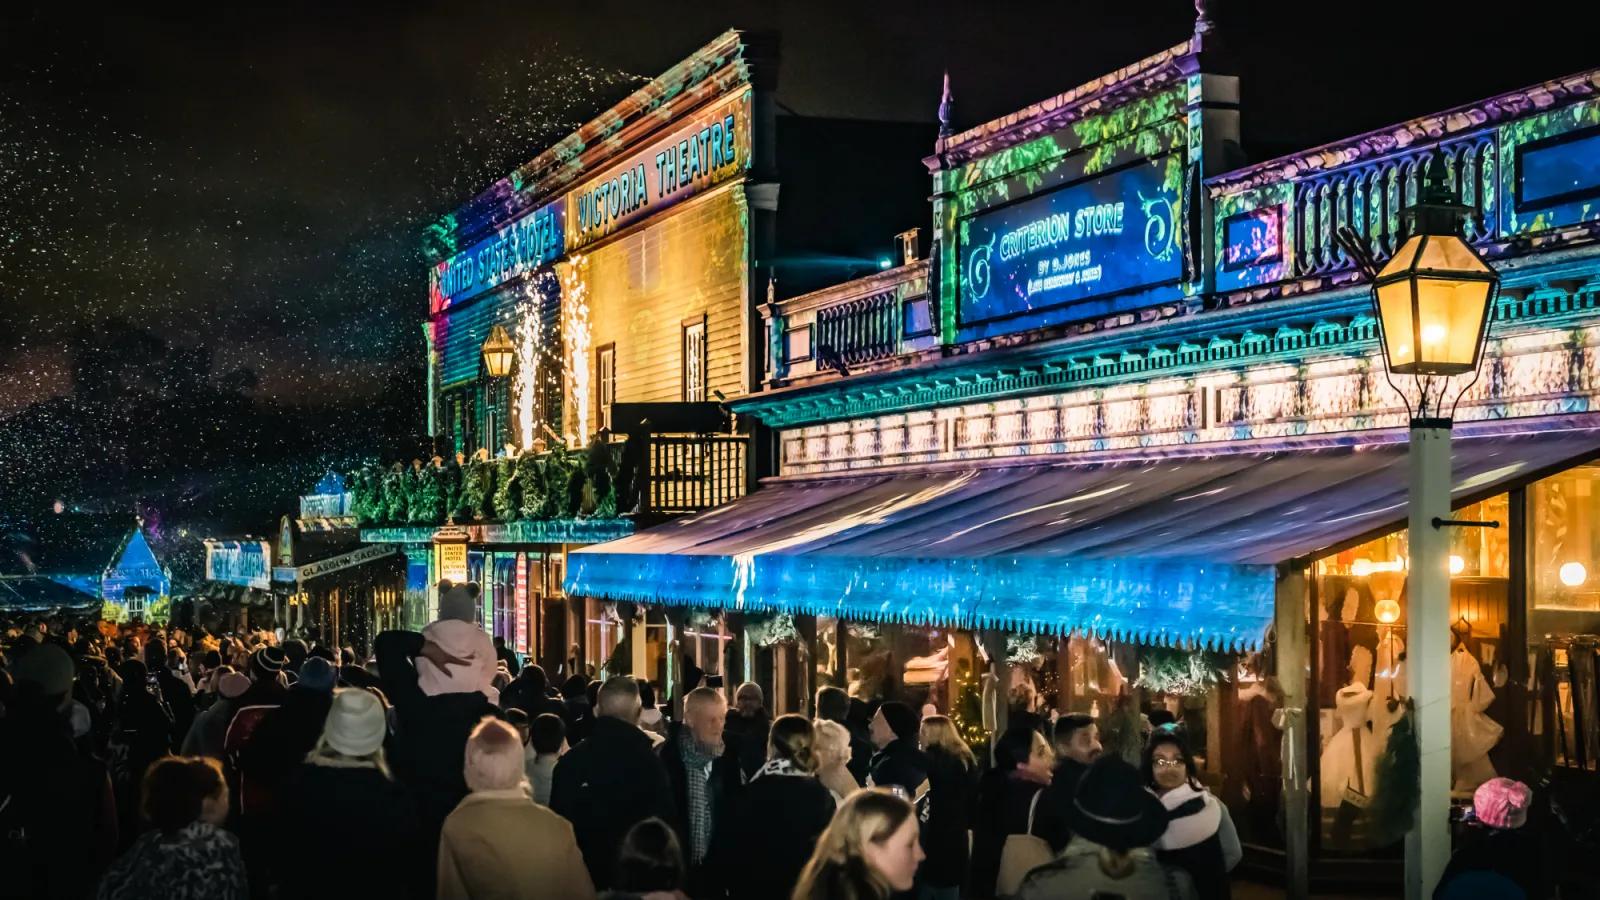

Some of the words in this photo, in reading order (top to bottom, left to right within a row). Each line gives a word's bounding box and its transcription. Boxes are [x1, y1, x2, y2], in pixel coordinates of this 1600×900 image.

[579, 163, 648, 231] VICTORIA
[655, 114, 735, 198] THEATRE
[440, 256, 474, 297] UNITED
[478, 234, 519, 285] STATES
[520, 214, 557, 264] HOTEL
[1000, 212, 1069, 261] CRITERION
[1074, 202, 1124, 238] STORE
[1038, 260, 1050, 276] BY
[303, 556, 350, 577] GLASGOW
